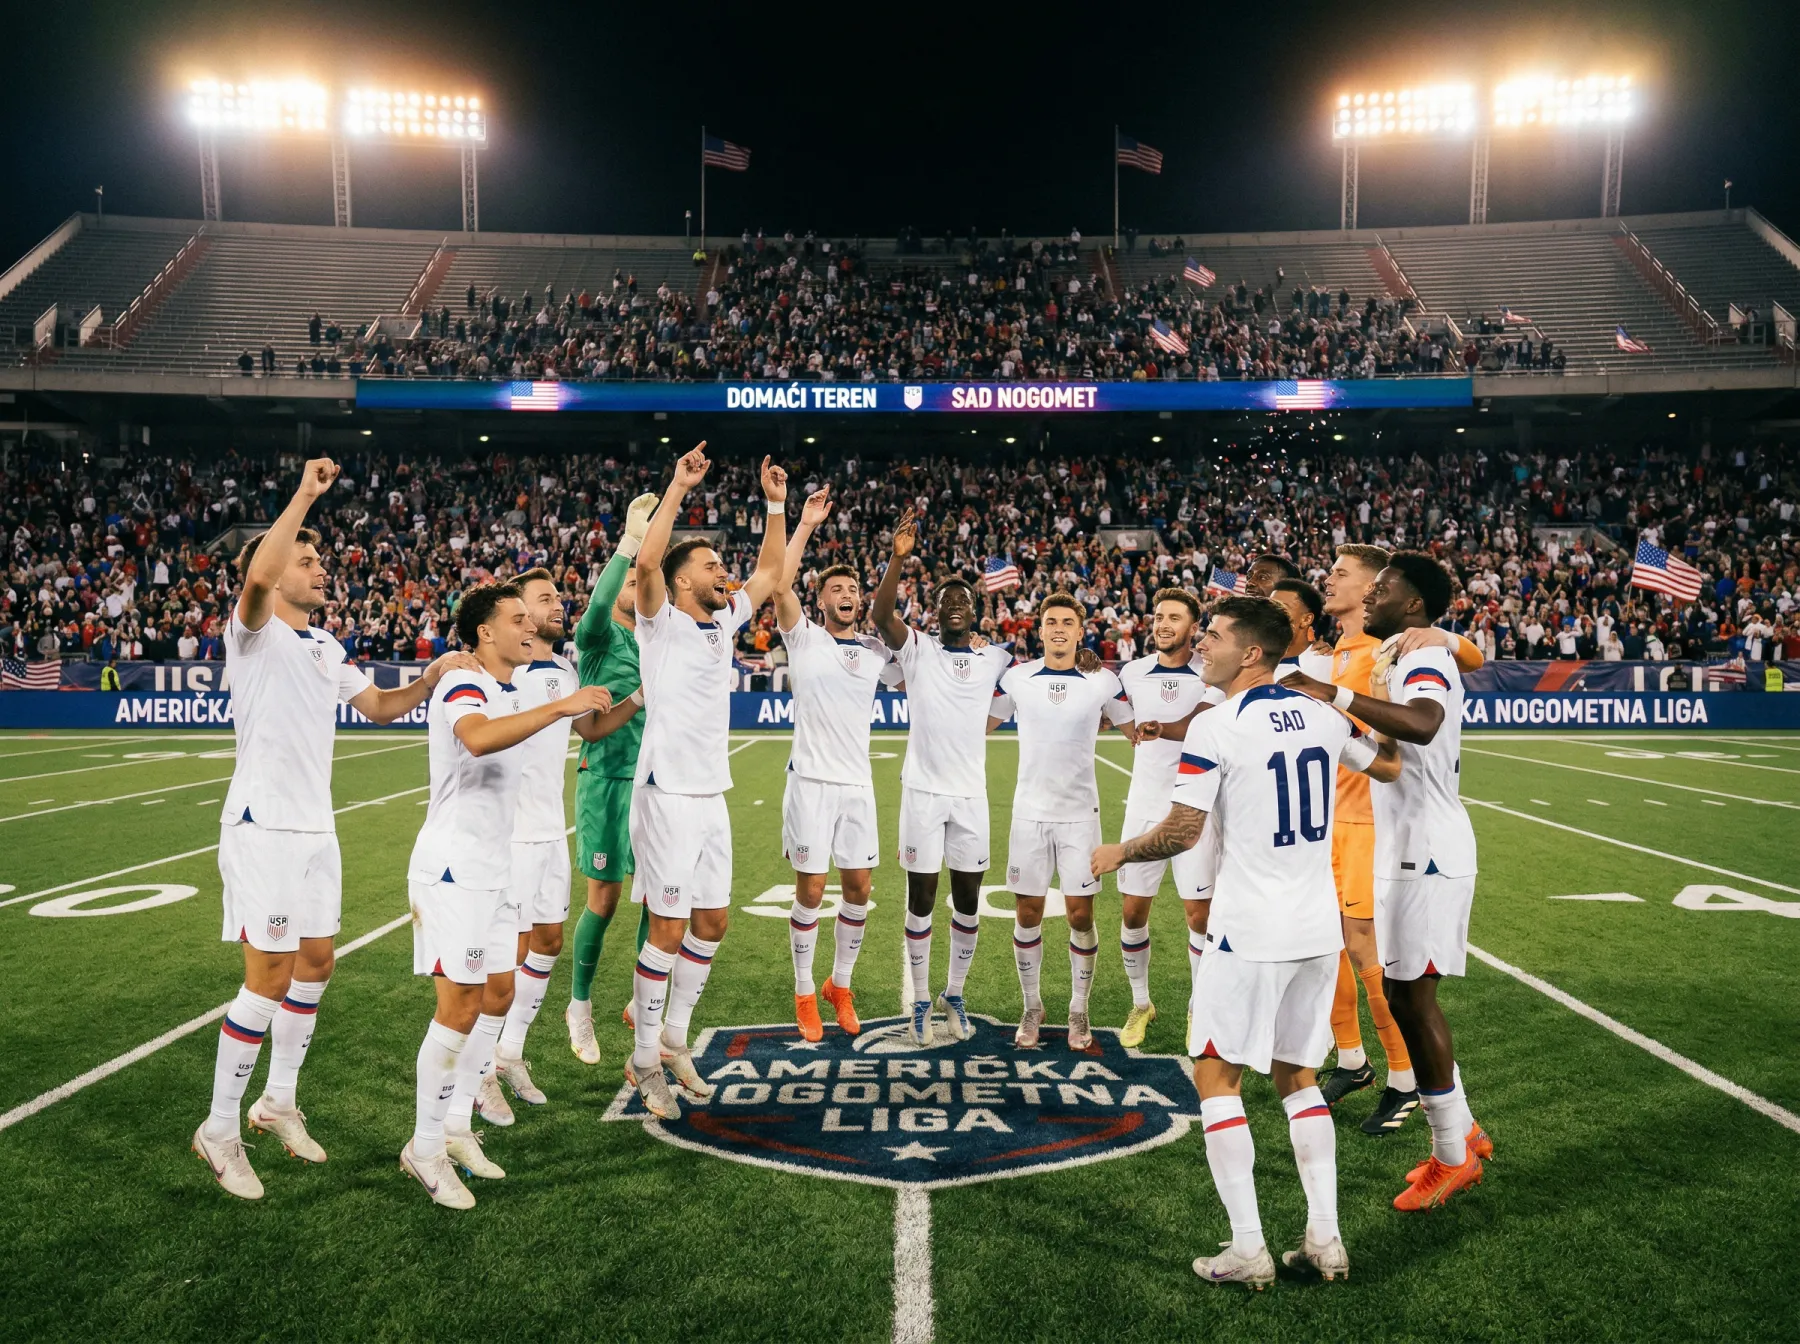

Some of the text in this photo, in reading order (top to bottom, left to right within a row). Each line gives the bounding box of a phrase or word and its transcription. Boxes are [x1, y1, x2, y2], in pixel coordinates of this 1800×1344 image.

[727, 382, 877, 408] DOMAĆI TEREN
[951, 387, 1098, 408] SAD NOGOMET
[115, 692, 235, 723] AMERIČKA
[1496, 698, 1647, 723] NOGOMETNA
[1654, 698, 1708, 723] LIGA
[1269, 709, 1306, 733] SAD
[1267, 746, 1330, 847] 10
[707, 1055, 1123, 1081] AMERIČKA
[821, 1107, 1013, 1132] LIGA
